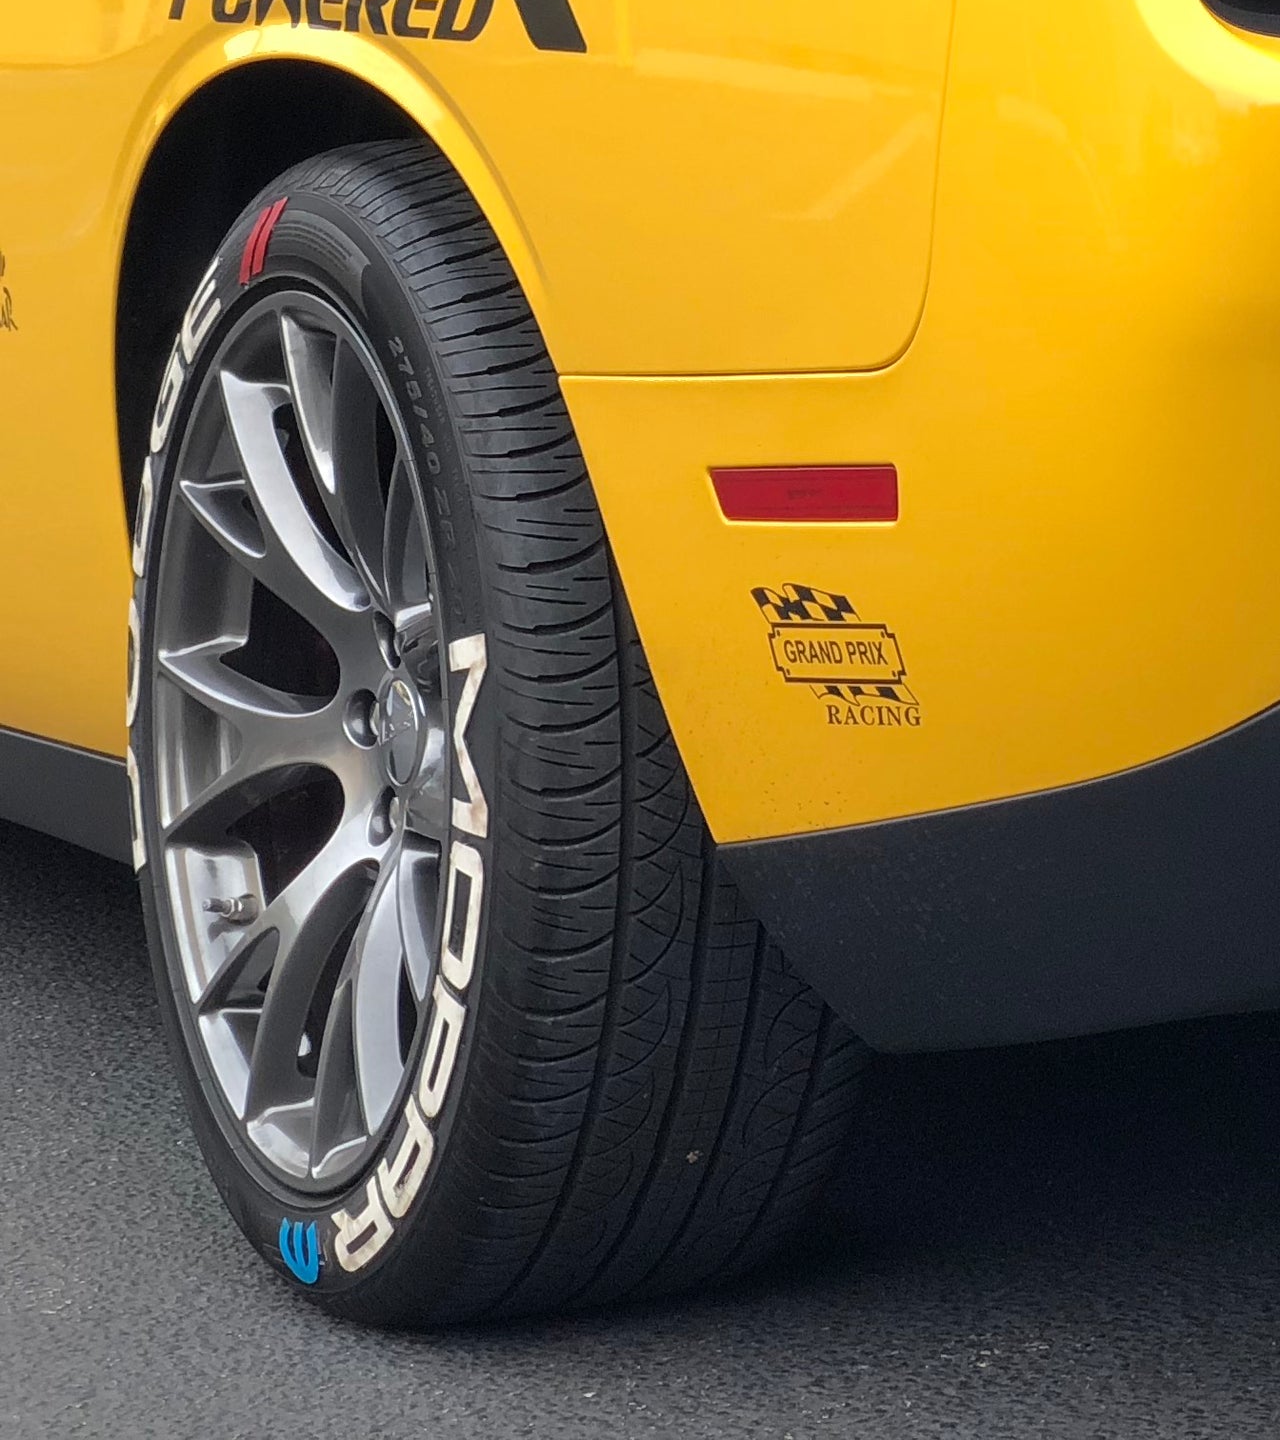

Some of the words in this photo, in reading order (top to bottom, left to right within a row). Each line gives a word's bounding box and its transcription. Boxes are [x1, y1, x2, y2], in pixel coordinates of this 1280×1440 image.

[783, 640, 843, 664] GRAND
[845, 641, 888, 665] PRIX
[826, 705, 921, 726] RACING
[333, 633, 488, 1273] MOPAR
